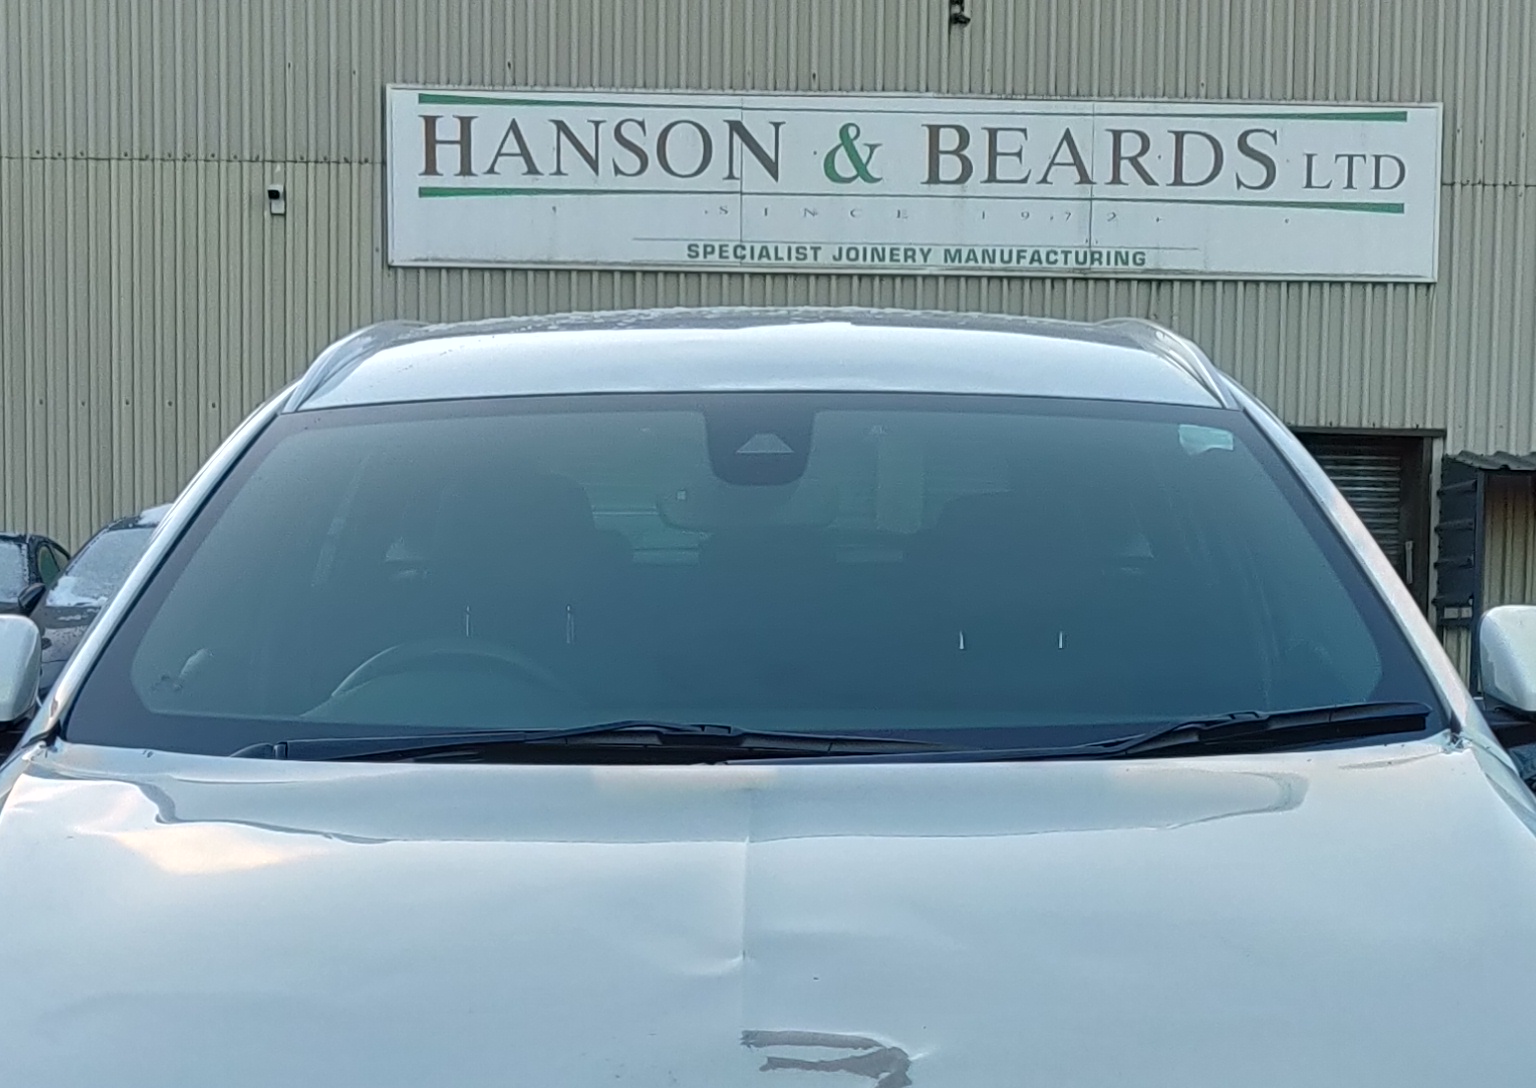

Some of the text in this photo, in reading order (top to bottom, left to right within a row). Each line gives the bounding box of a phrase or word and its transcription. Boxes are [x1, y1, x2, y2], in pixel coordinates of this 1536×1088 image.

[417, 114, 1407, 192] HANSON & BEARDS LTD
[686, 242, 1148, 267] SPECIALIST JOINERY MANUFACTURING
